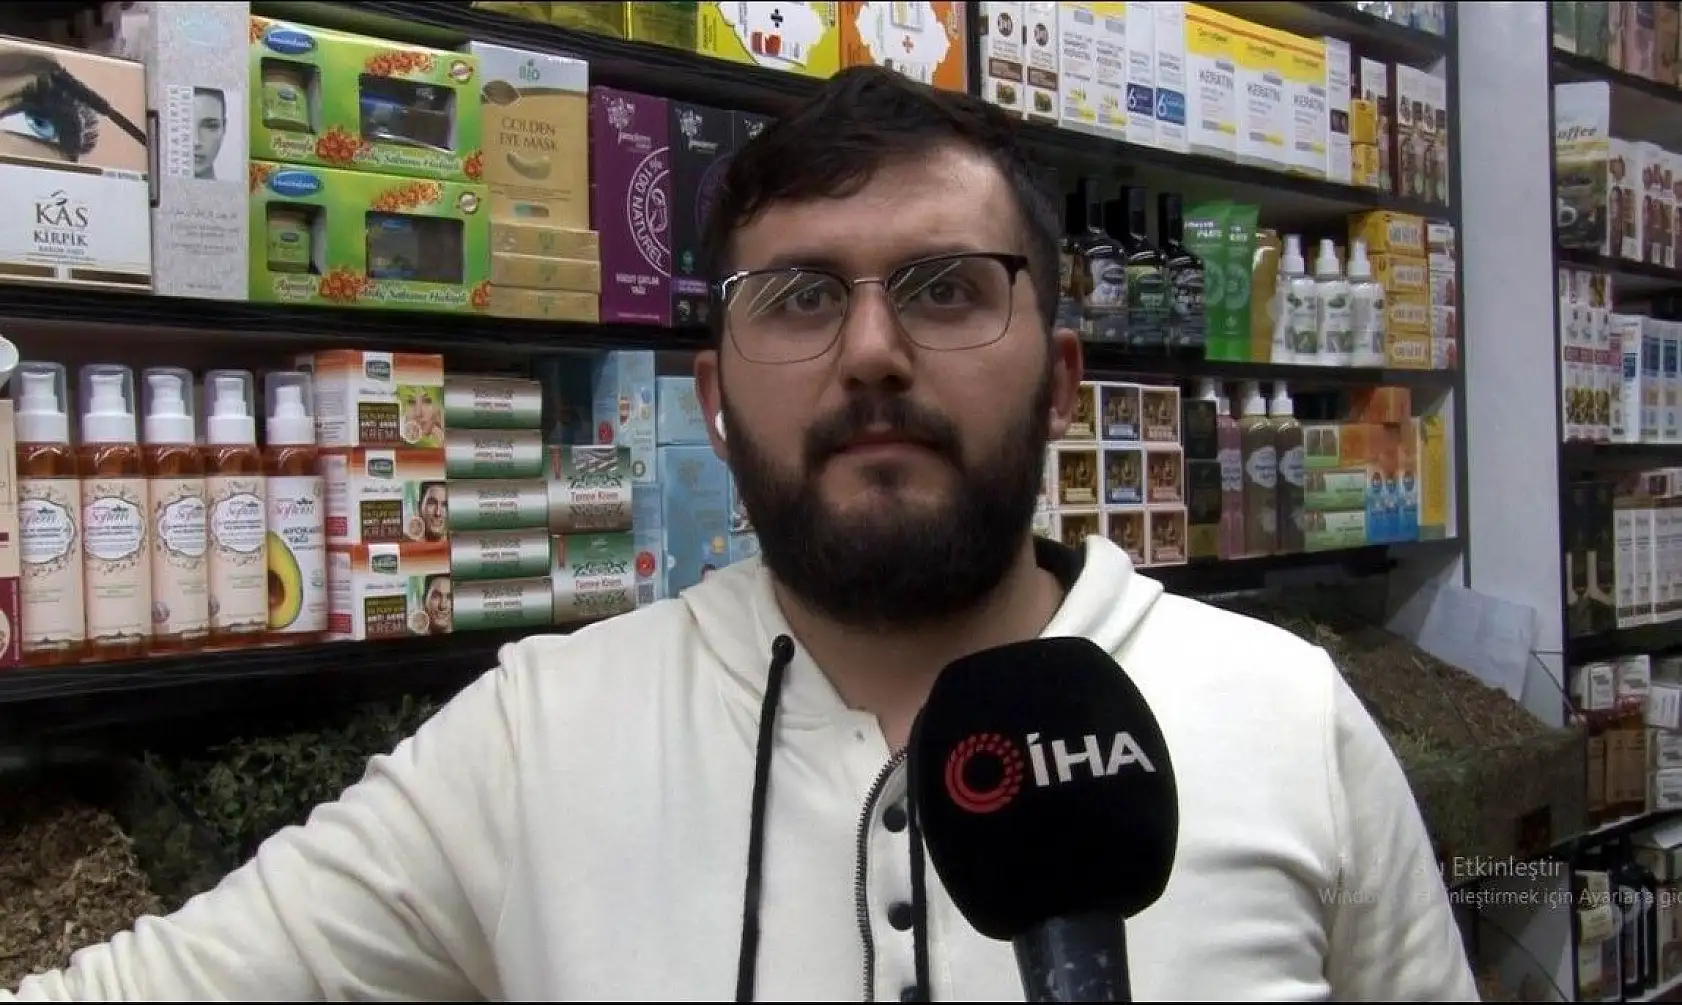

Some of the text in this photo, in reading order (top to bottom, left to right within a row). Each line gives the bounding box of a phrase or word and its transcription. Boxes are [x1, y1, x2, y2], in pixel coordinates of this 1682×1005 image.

[1158, 93, 1168, 117] 6
[501, 117, 556, 135] GOLDEN
[1556, 125, 1598, 142] offee
[1026, 731, 1156, 786] İHA
